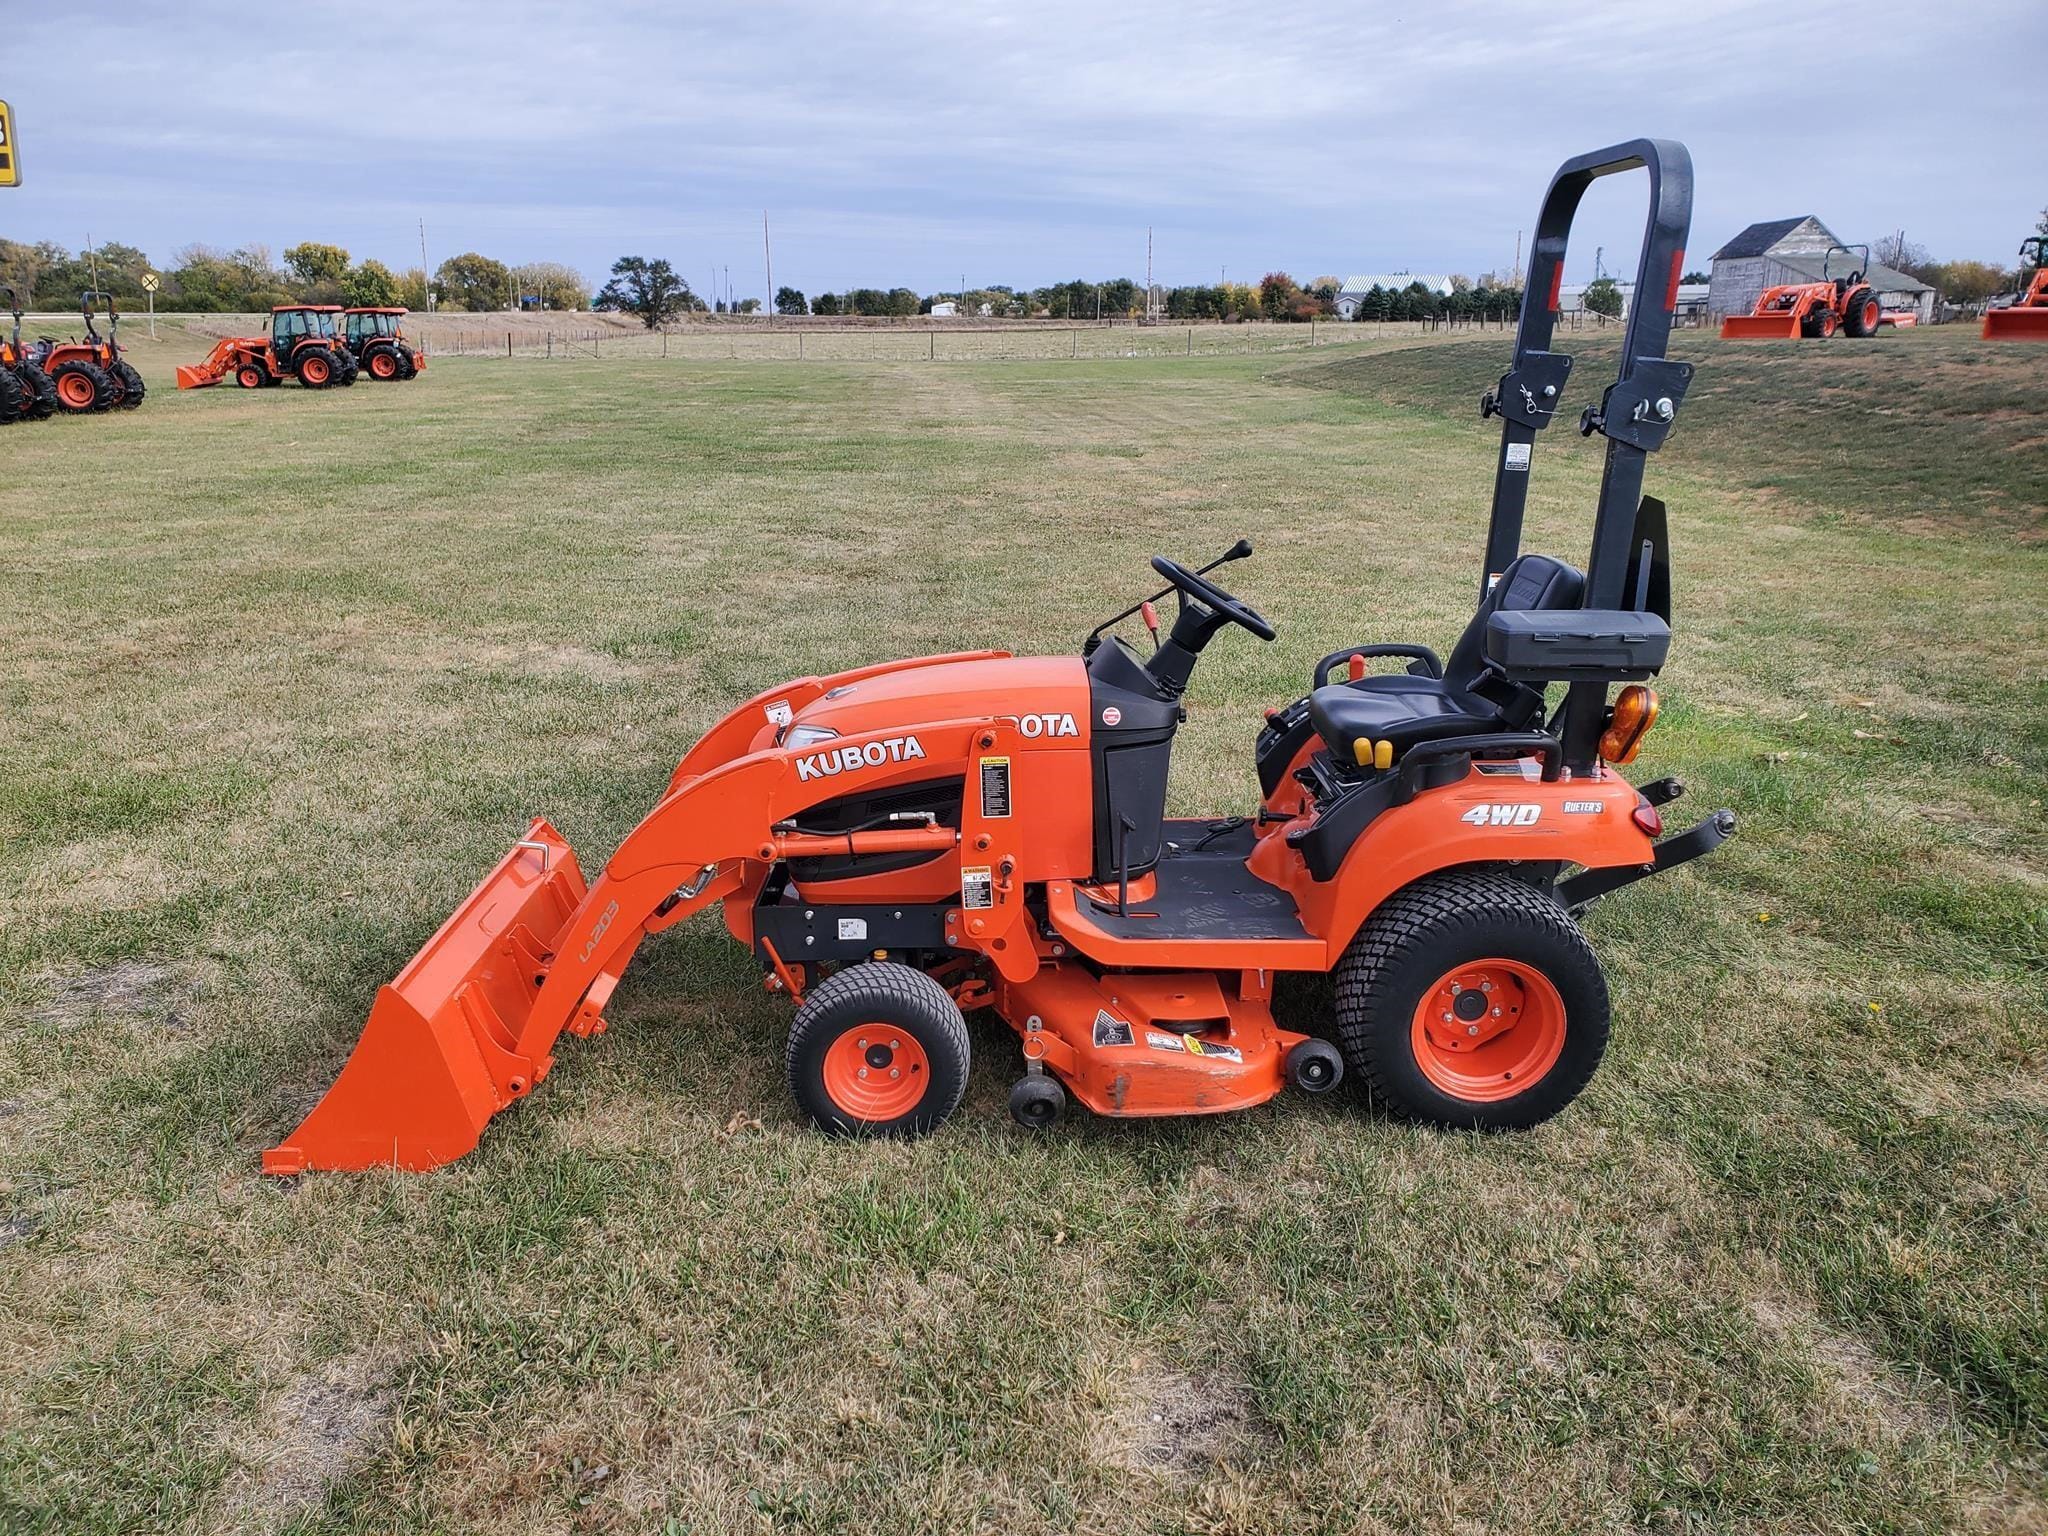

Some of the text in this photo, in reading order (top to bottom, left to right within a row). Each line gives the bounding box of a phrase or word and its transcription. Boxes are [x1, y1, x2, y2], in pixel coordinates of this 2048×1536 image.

[1015, 713, 1080, 738] OTA
[795, 736, 926, 781] KUBOTA
[1460, 804, 1542, 826] 4WD
[1564, 801, 1602, 813] RUETER'S
[579, 899, 619, 963] LA203
